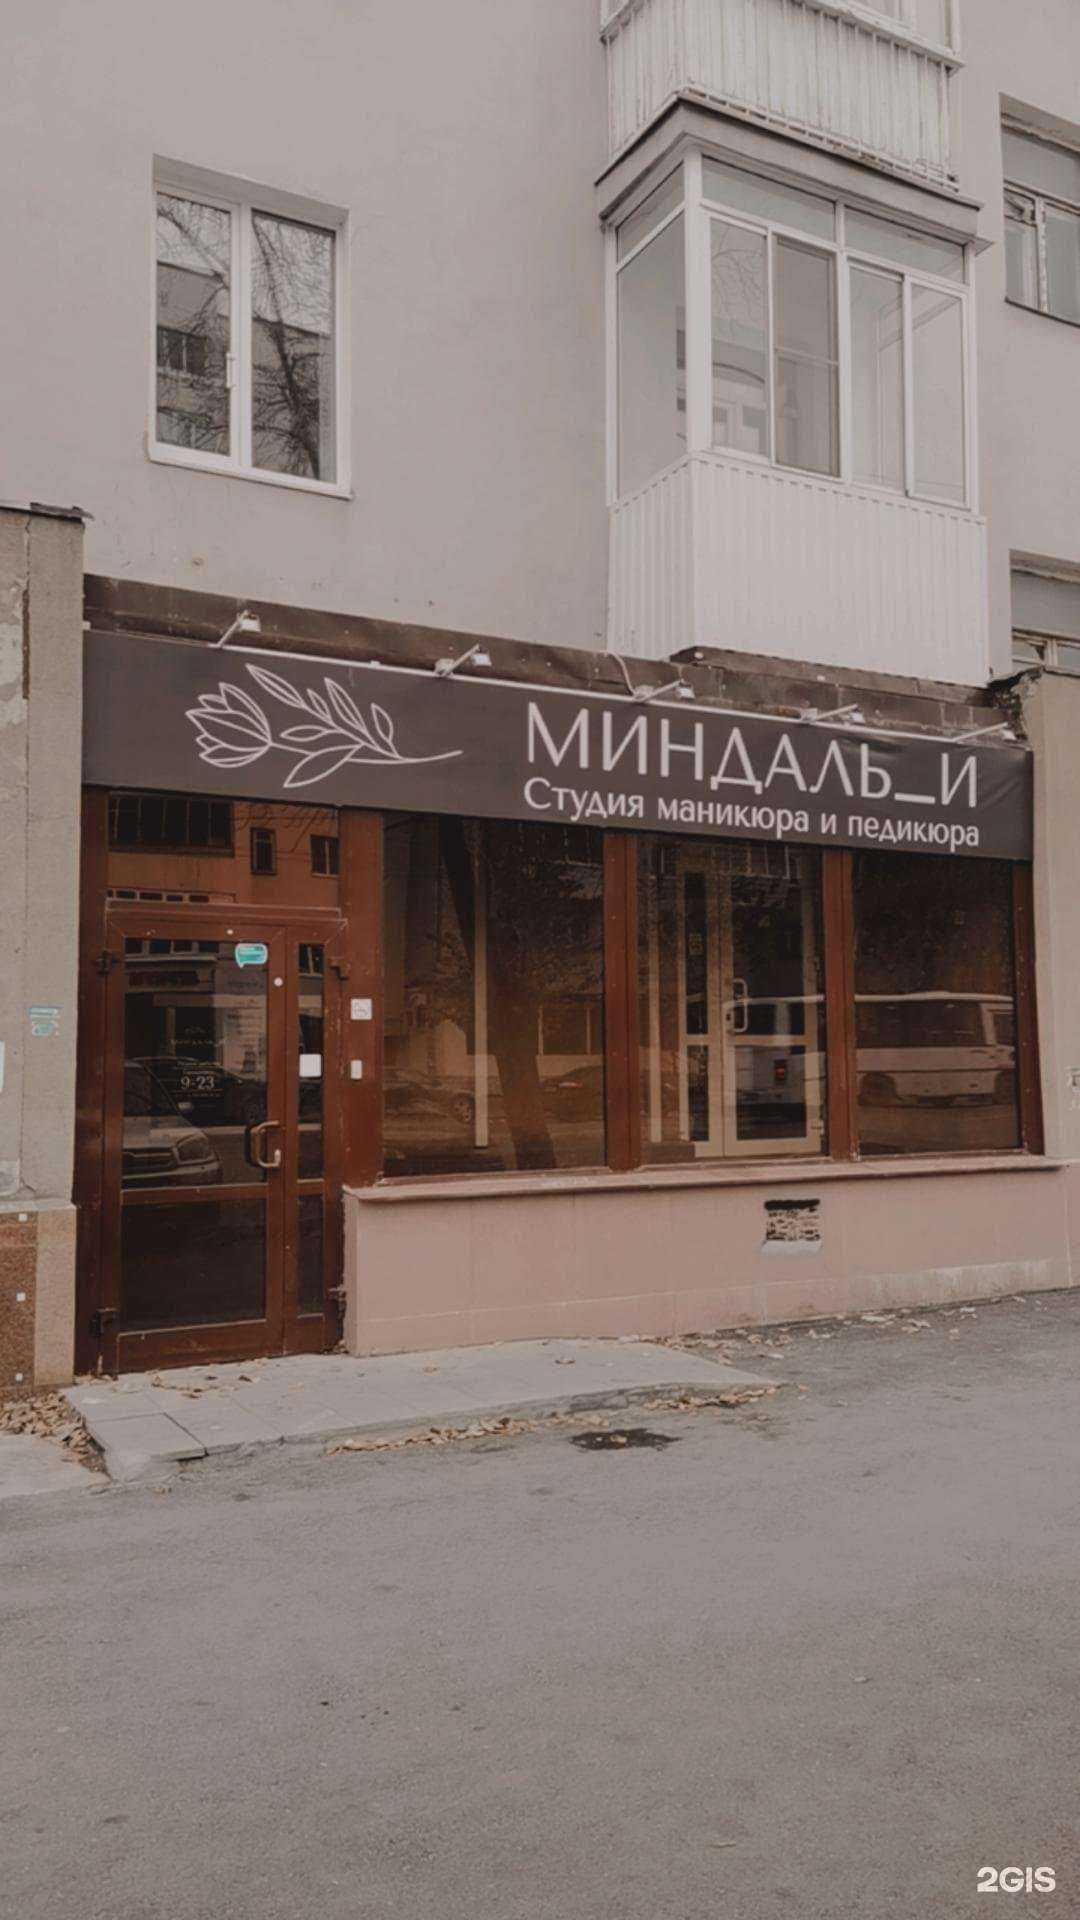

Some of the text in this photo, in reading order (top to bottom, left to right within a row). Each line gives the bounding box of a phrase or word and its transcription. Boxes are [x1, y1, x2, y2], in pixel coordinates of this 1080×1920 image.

[528, 702, 977, 808] МИНДАЛЬ_И
[523, 776, 980, 853] Студия маникюра и педикюра
[180, 1075, 215, 1090] 9-23
